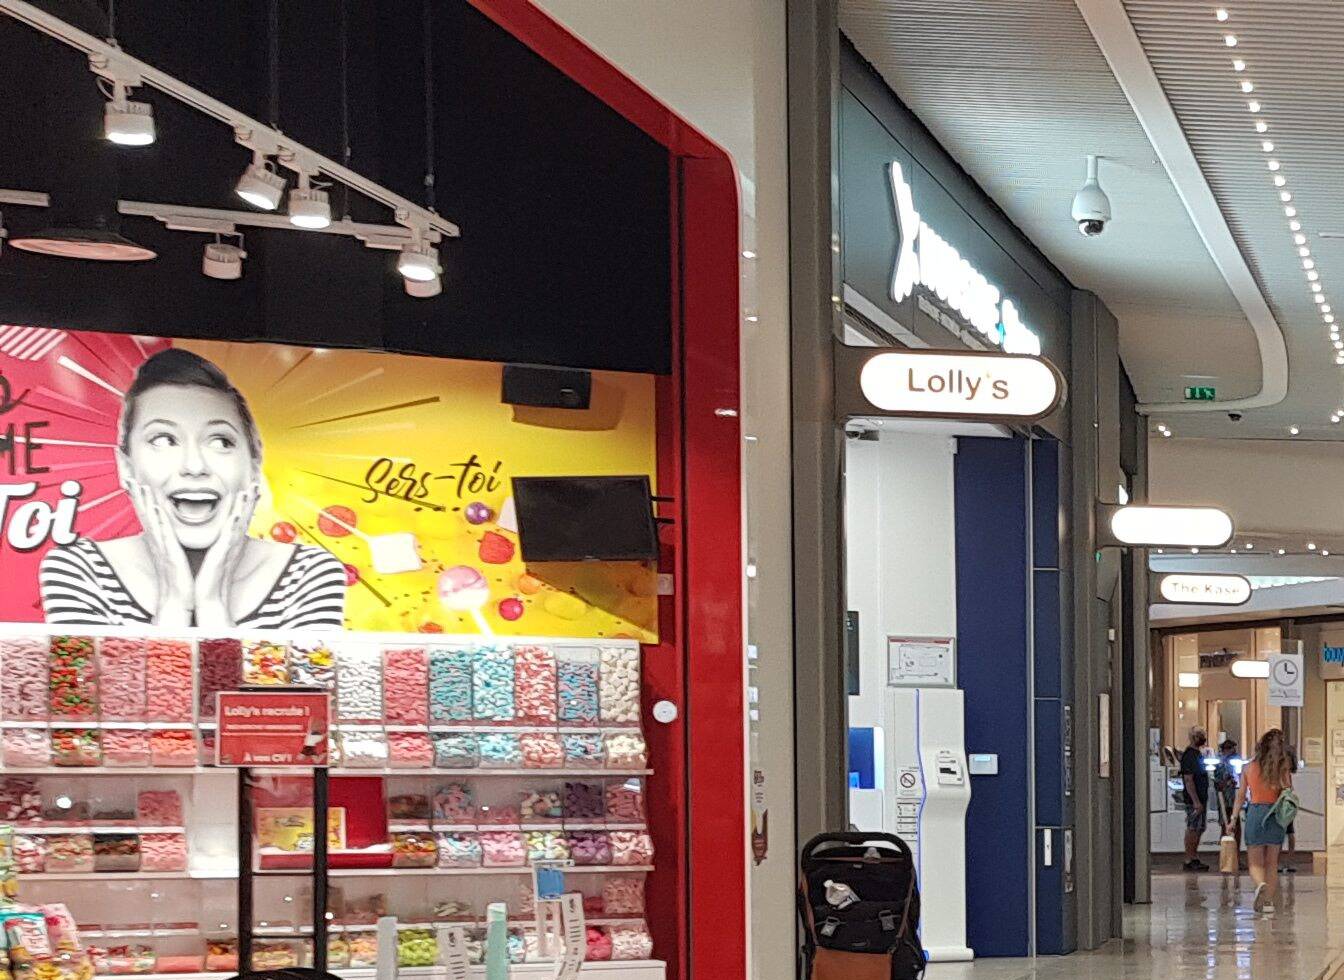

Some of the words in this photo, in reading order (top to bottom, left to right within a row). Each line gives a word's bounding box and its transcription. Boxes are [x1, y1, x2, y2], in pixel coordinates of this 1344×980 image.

[908, 368, 1009, 400] Lolly's
[361, 454, 502, 503] Sers-toi
[1171, 582, 1199, 593] The
